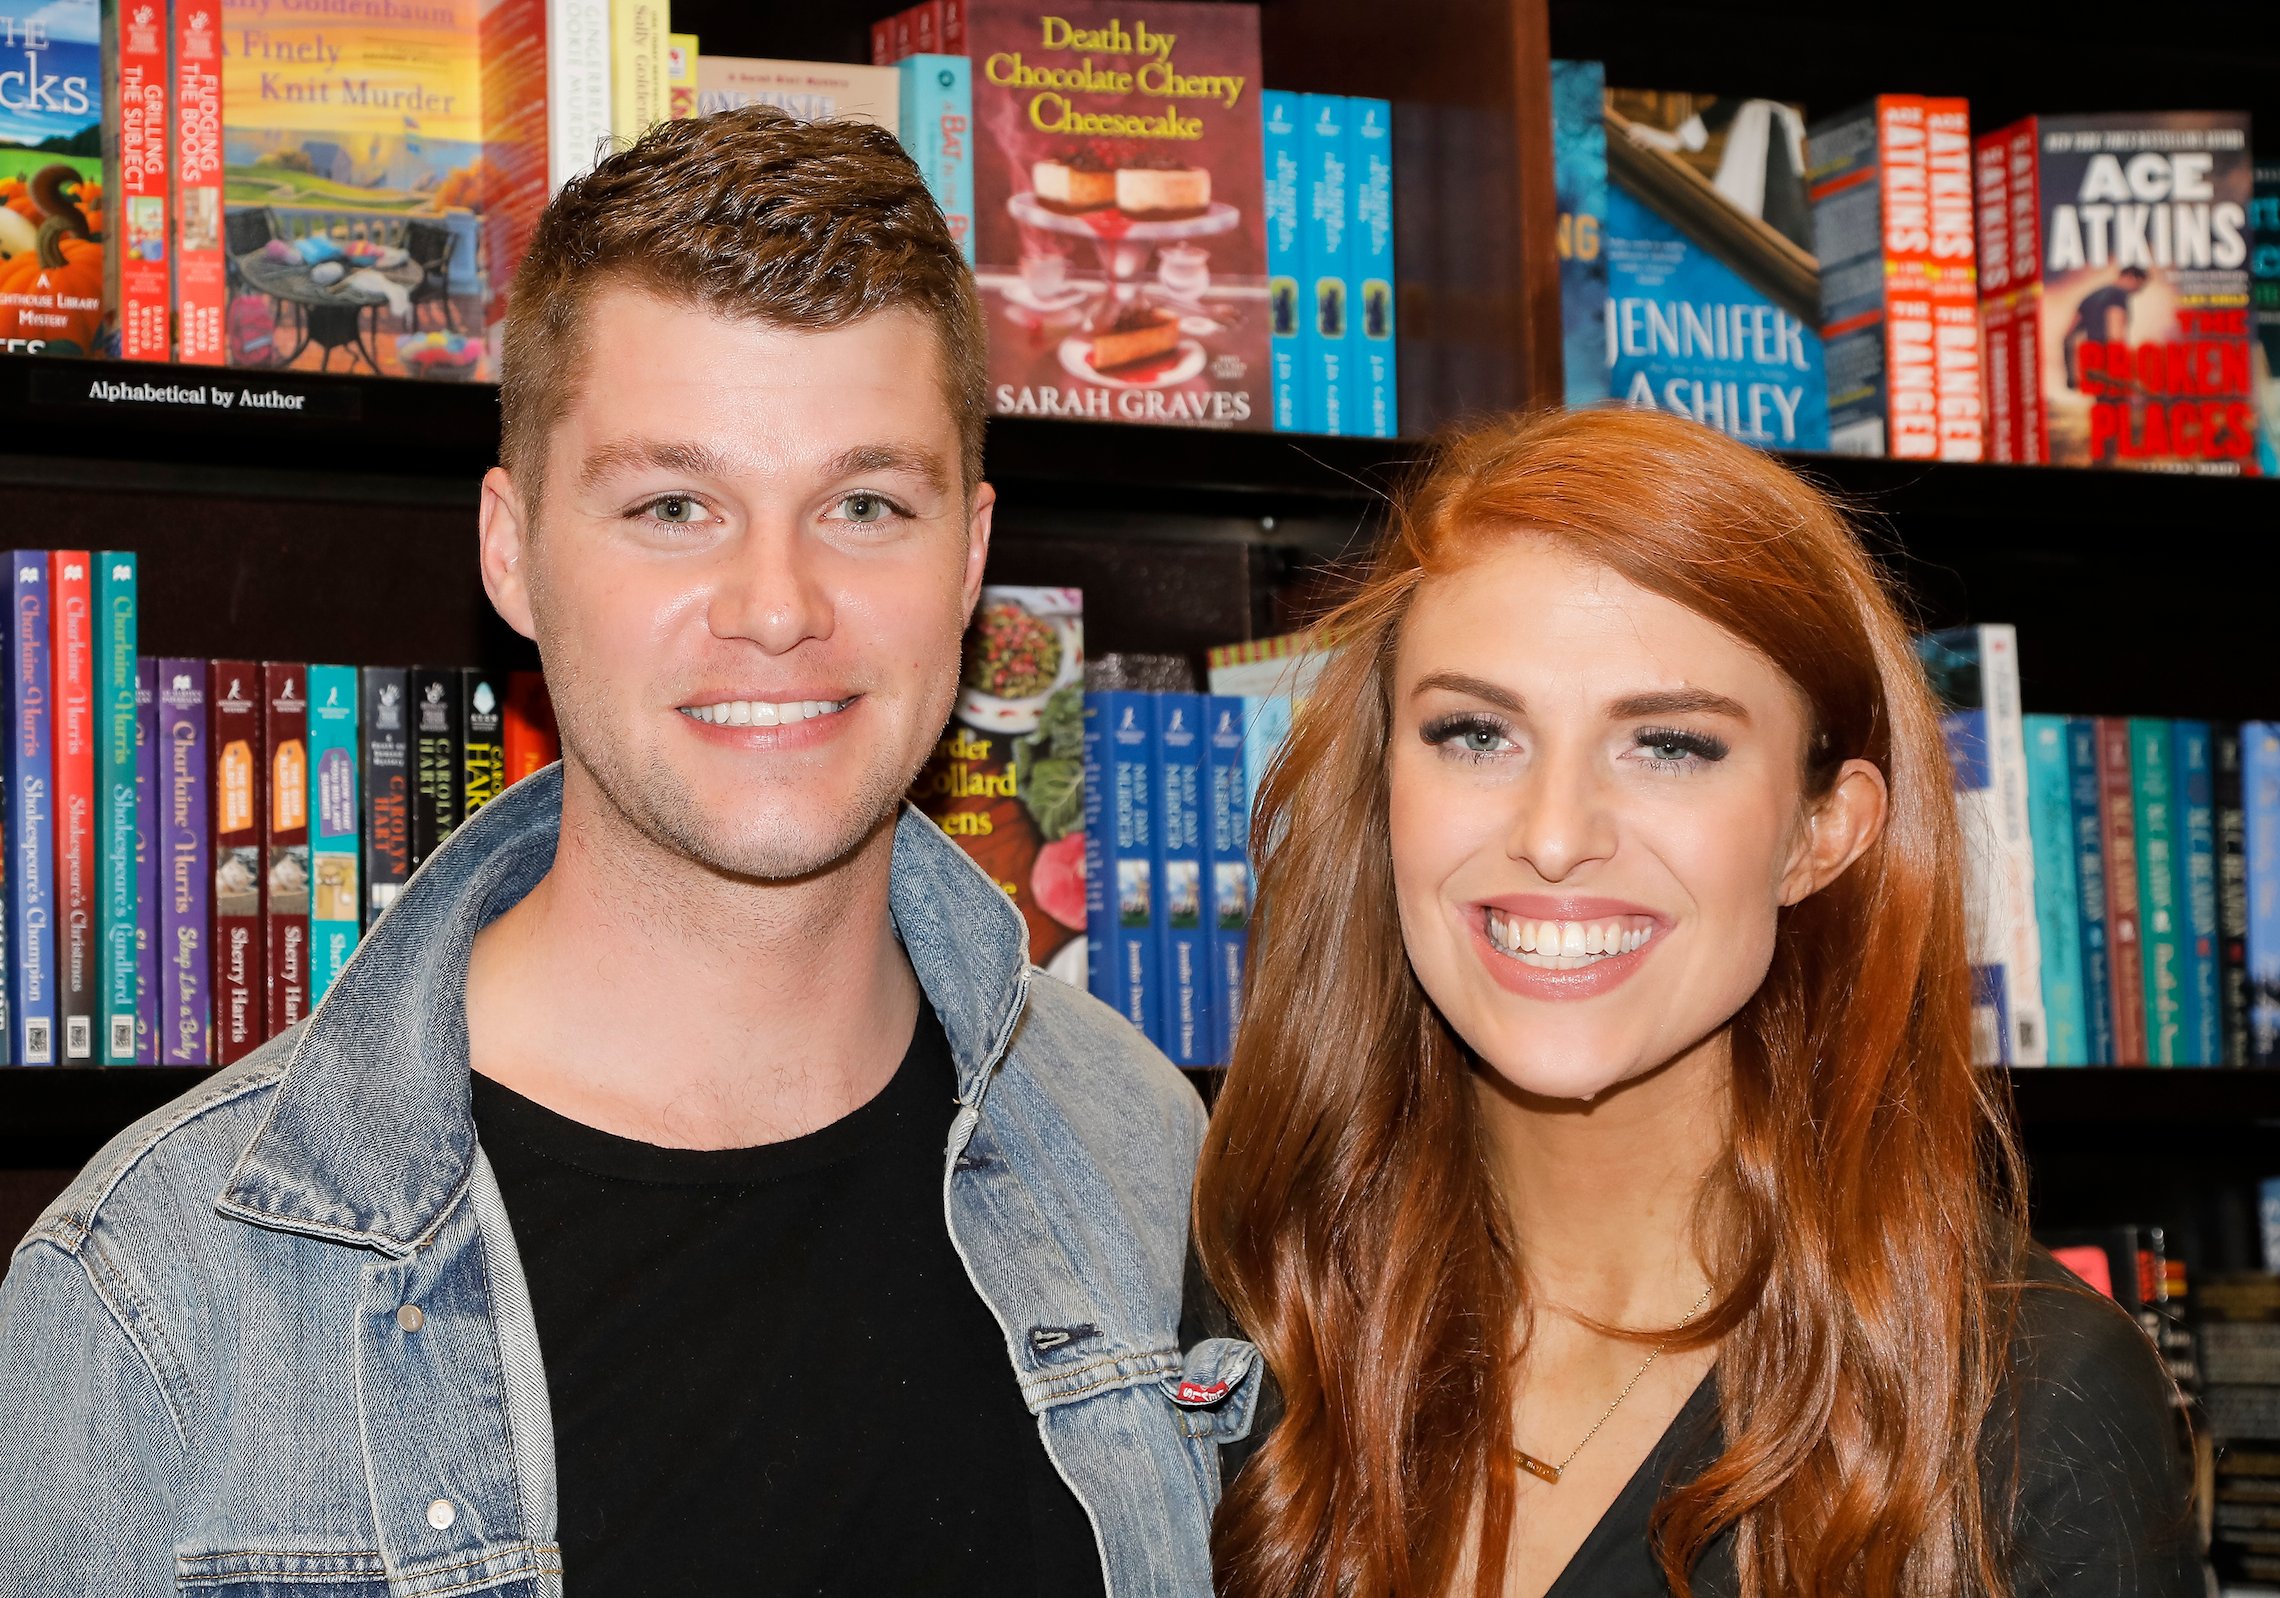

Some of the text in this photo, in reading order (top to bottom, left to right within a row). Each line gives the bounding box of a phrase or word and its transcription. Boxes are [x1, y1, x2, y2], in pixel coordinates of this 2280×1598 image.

[243, 30, 342, 73] Finely
[630, 4, 651, 47] Sally
[1041, 16, 1176, 63] Death by
[124, 64, 144, 103] THE
[181, 62, 199, 103] THE
[260, 73, 457, 114] Knit Murder
[985, 53, 1245, 109] Chocolate Cherry
[1028, 92, 1203, 139] Cheesecake
[124, 107, 144, 193] SUBJECT
[144, 84, 164, 174] GRILLING
[181, 108, 201, 182] BOOKS
[199, 74, 219, 172] FUDGING
[941, 114, 968, 160] BAT
[1886, 125, 1929, 253] ATKINS
[1928, 131, 1973, 259] ATKINS
[2079, 152, 2215, 201] ACE
[1980, 163, 2009, 290] ATKINS
[2011, 153, 2036, 280] ATKINS
[2047, 202, 2247, 272] ATKINS
[37, 272, 51, 289] A
[1604, 297, 1811, 372] JENNIFER
[2176, 310, 2250, 336] THE
[89, 380, 305, 410] Alphabetical by Author
[996, 384, 1251, 420] SARAH GRAVES
[1891, 320, 1937, 459] RANGER
[1936, 325, 1983, 462] RANGER
[2077, 340, 2250, 397] BROKEN
[1625, 371, 1805, 443] ASHLEY
[2090, 402, 2256, 461] PLACES
[172, 720, 197, 828] Charlaine
[419, 738, 436, 798] HART
[464, 743, 491, 820] HAR
[490, 745, 504, 798] CARO
[942, 729, 993, 761] rder
[20, 595, 47, 1002] Charlaine Harris Shakespeare's Champion
[66, 596, 88, 993] Charlaine Harris Shakespeare's Christmas
[109, 596, 135, 1006] Charlaine Harris Shakespeare's Landlord
[374, 797, 391, 852] HART
[390, 775, 406, 875] CAROLYN
[1116, 761, 1134, 849] MURDER
[1133, 763, 1149, 846] MAY DAY
[1166, 763, 1184, 850] MURDER
[1182, 765, 1199, 849] MAY DAY
[1214, 765, 1232, 851] MURDER
[1231, 766, 1248, 850] MAY DAY
[174, 828, 199, 915] Harris
[229, 927, 250, 1043] Sherry Harris
[282, 926, 303, 1027] Sherry Harr
[1182, 1387, 1224, 1402] LEVI'S
